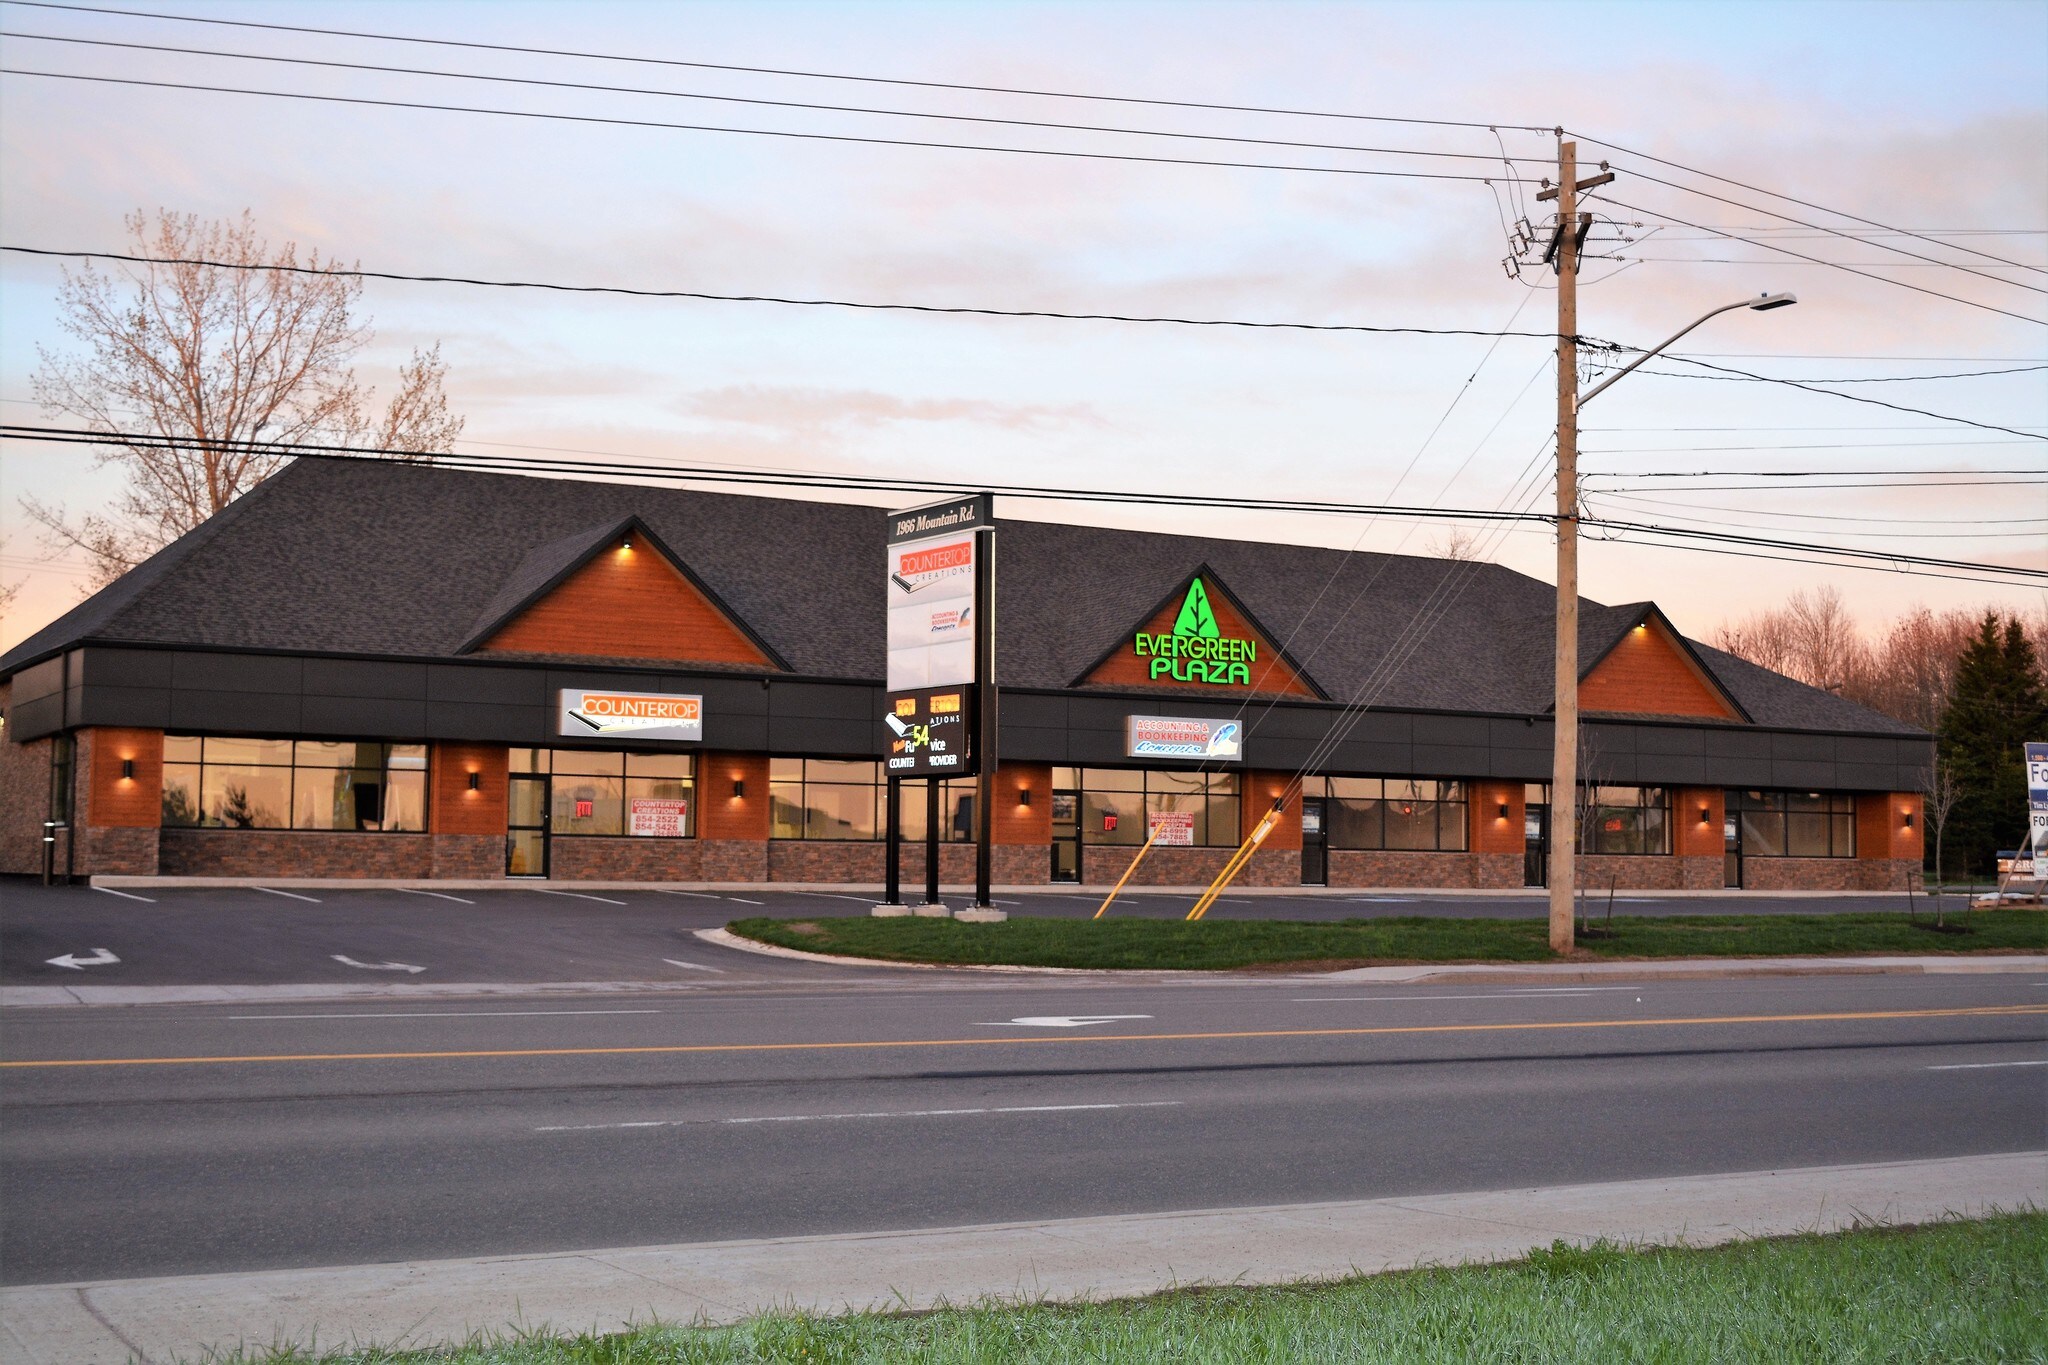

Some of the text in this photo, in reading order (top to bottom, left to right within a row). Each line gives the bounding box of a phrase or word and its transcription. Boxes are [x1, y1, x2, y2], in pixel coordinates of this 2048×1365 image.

[896, 504, 976, 536] 1966 Mountain Rd.
[901, 547, 970, 574] COUNTERTOP
[915, 565, 972, 582] CREATIONS
[1136, 633, 1256, 662] EVERGREEN
[1150, 657, 1250, 685] PLAZA
[582, 699, 698, 718] COUNTERTOP
[609, 716, 700, 729] CREATIONS
[1137, 720, 1209, 733] ACCOUNTING &
[913, 724, 930, 747] 54
[1137, 731, 1208, 743] BOOKKEEPING
[1136, 741, 1202, 754] Concepts
[633, 800, 685, 808] COUNTERTOP
[635, 815, 679, 823] 854-2522
[635, 823, 678, 831] 854-5426
